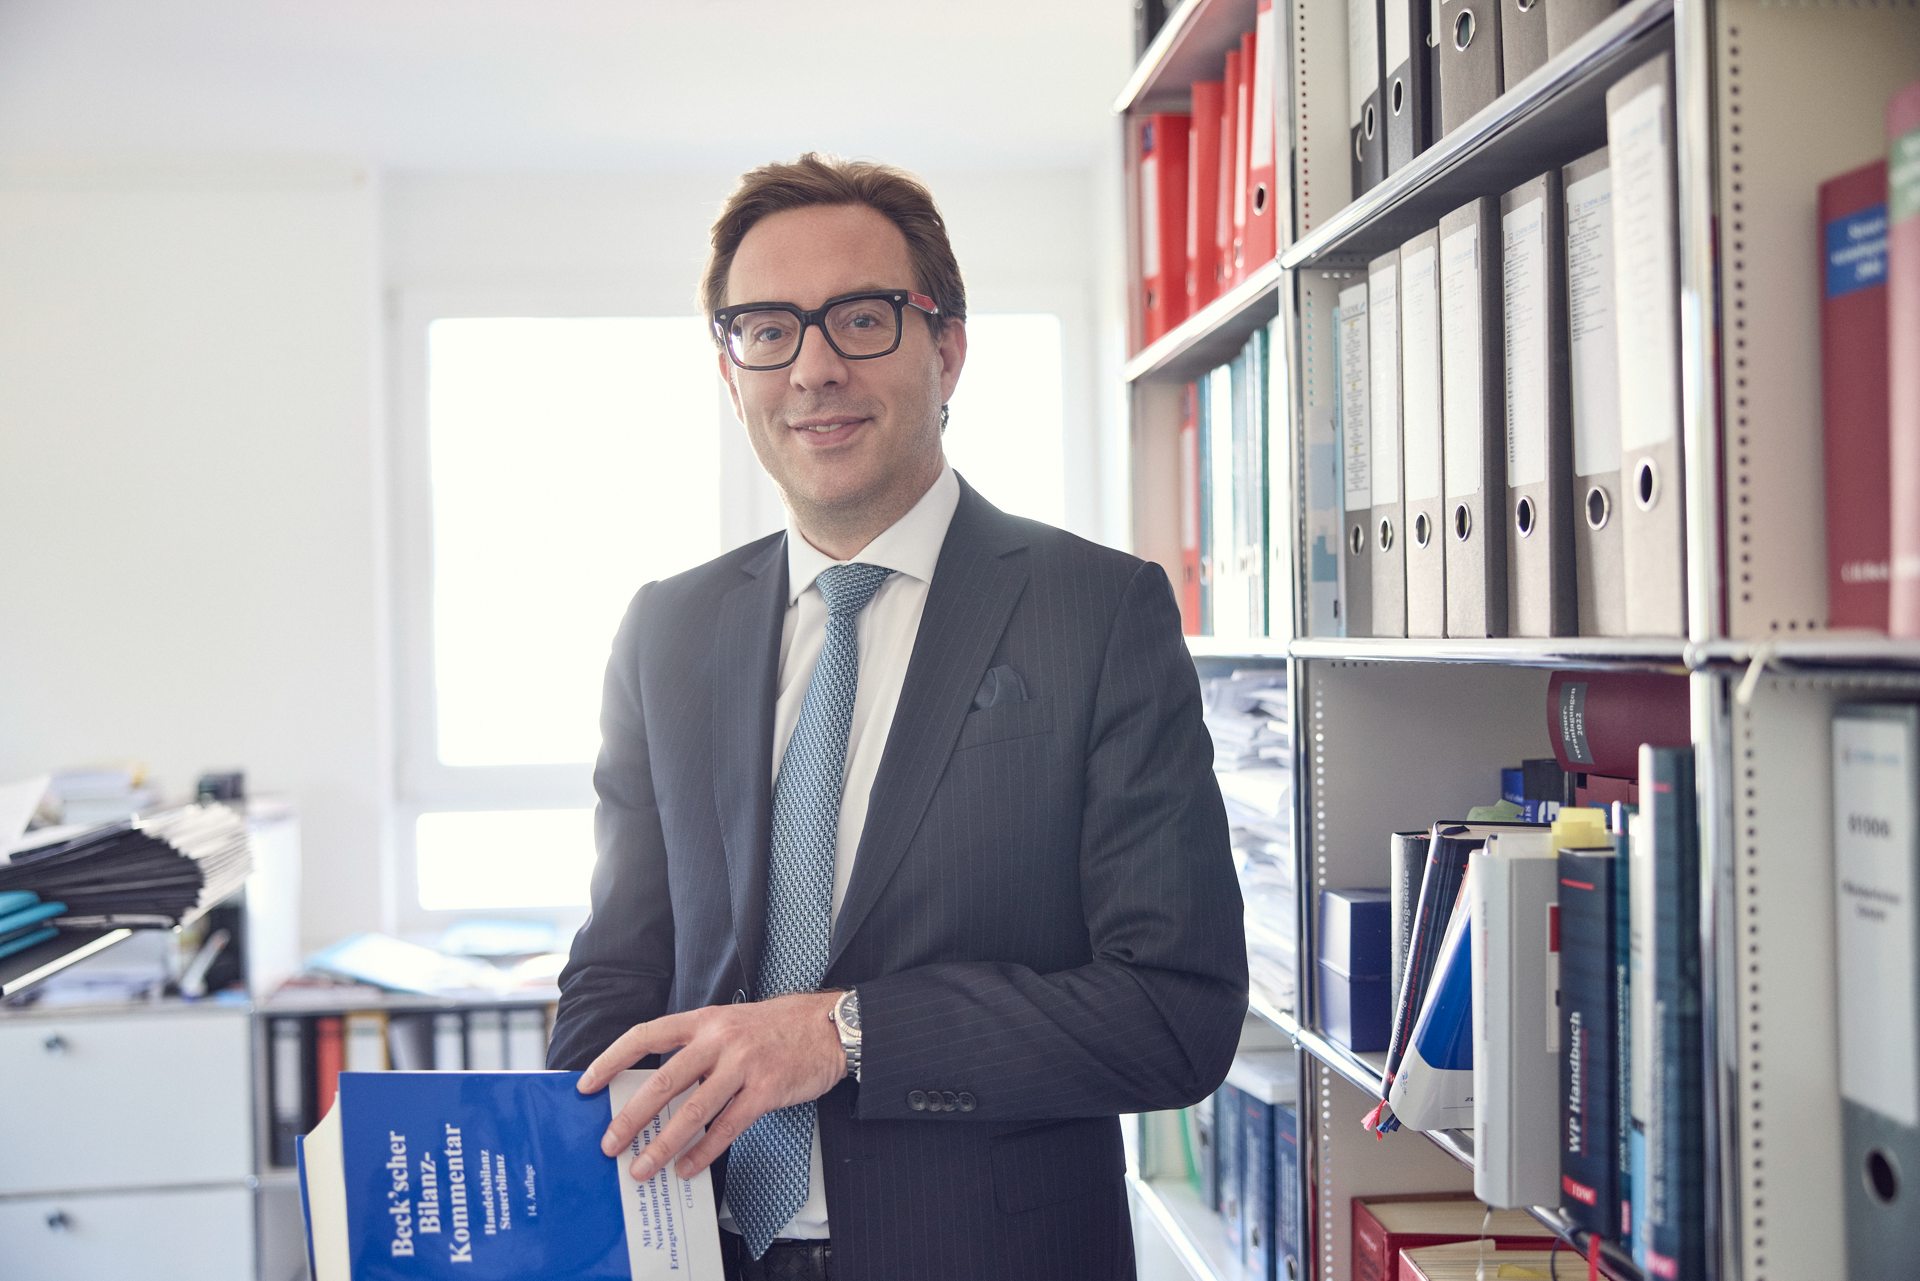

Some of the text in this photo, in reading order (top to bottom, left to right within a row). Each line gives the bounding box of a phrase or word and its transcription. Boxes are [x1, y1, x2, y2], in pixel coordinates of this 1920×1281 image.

[1562, 705, 1571, 741] Steuer-
[1569, 687, 1582, 759] veranlagungen
[1575, 712, 1583, 736] 2022
[1569, 1011, 1581, 1153] WP Handbuch
[386, 1130, 415, 1257] Beck'scher
[417, 1151, 442, 1234] Bilanz-
[444, 1123, 473, 1263] Kommentar
[480, 1149, 497, 1236] Handelsbilanz
[495, 1154, 511, 1230] Steuerbilanz
[524, 1164, 537, 1217] 14. Auflage
[636, 1184, 645, 1198] als
[639, 1202, 650, 1227] mehr
[643, 1129, 664, 1250] Neukommentie um
[643, 1229, 652, 1247] Mit
